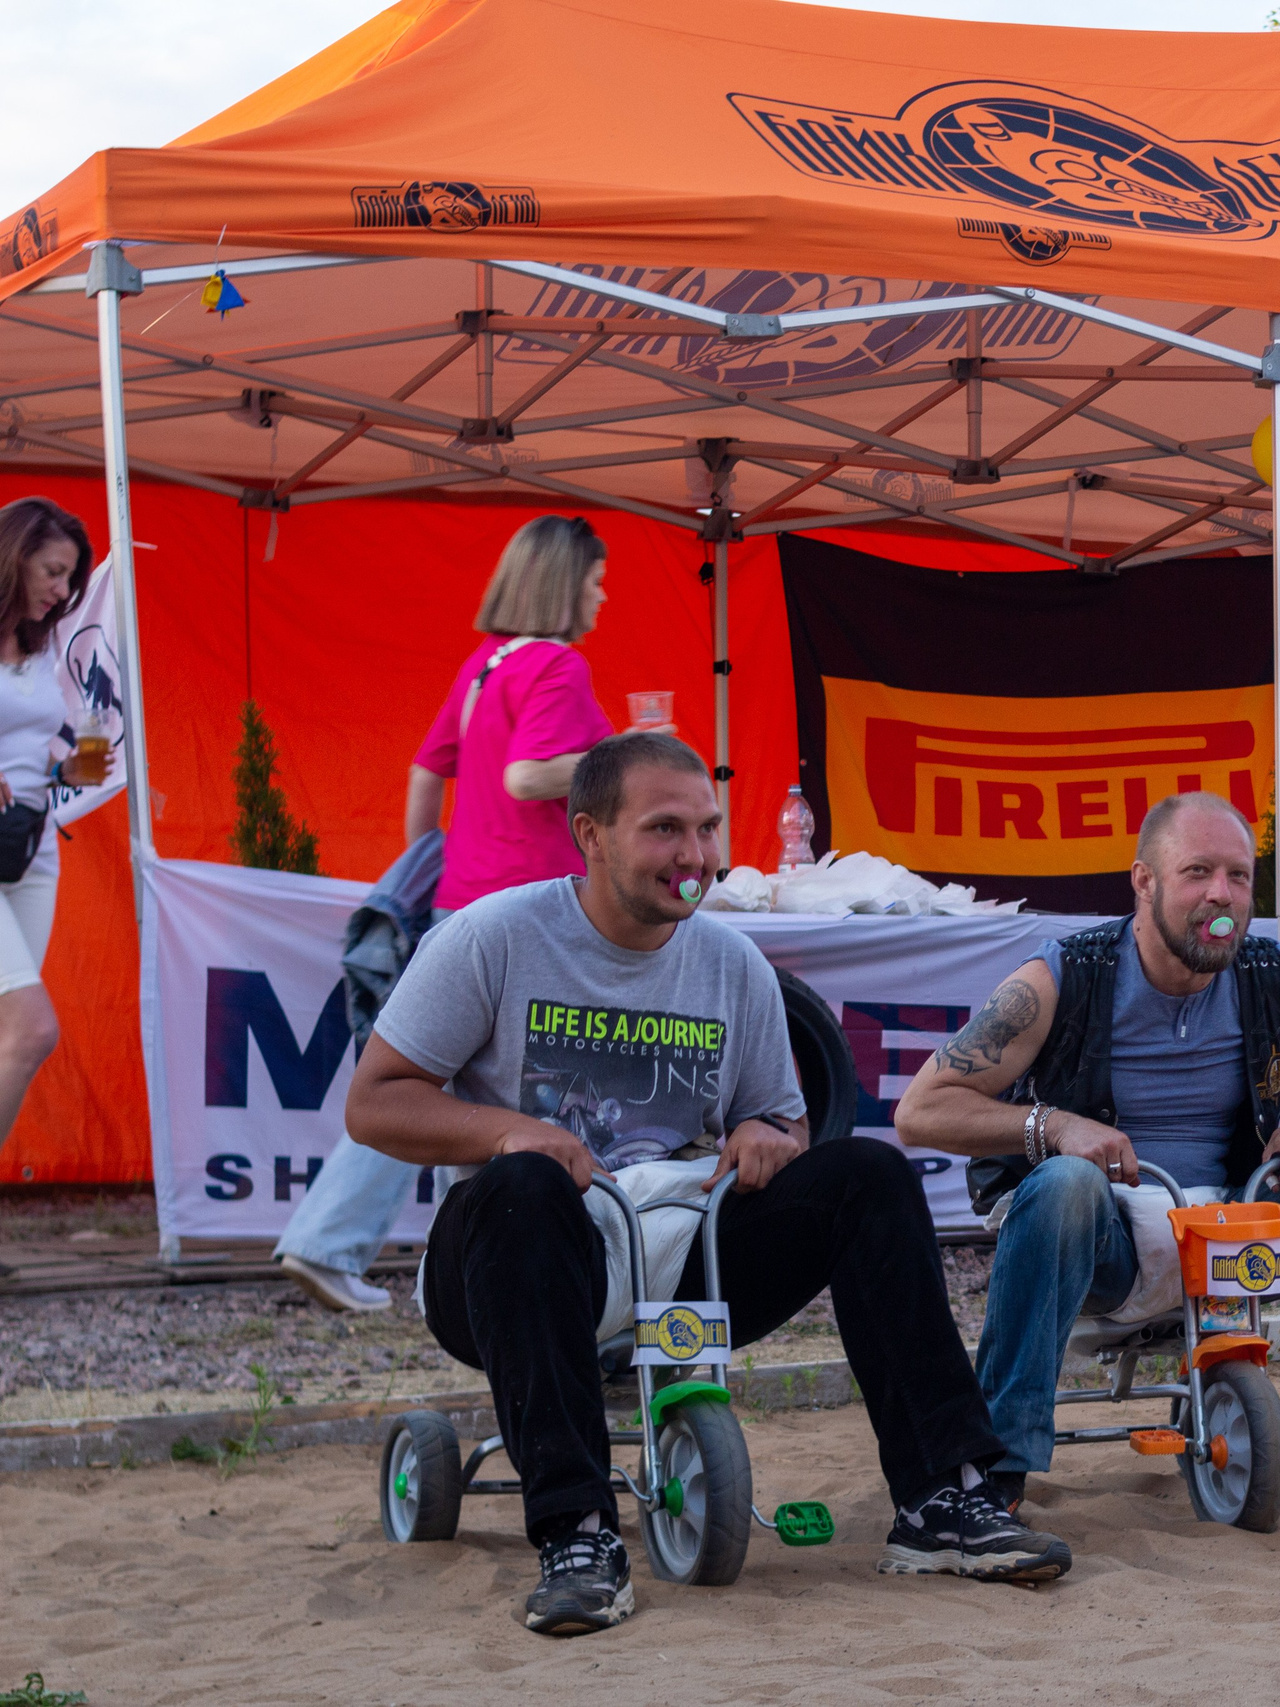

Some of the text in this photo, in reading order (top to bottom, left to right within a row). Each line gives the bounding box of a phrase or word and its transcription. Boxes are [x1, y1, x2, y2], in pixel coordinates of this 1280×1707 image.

[755, 110, 968, 194] БАЙК
[529, 1003, 725, 1050] LIFE IS A JOURNEY
[528, 1032, 719, 1062] MOTOCYCLES NIGH
[1214, 1257, 1238, 1279] БАЙК
